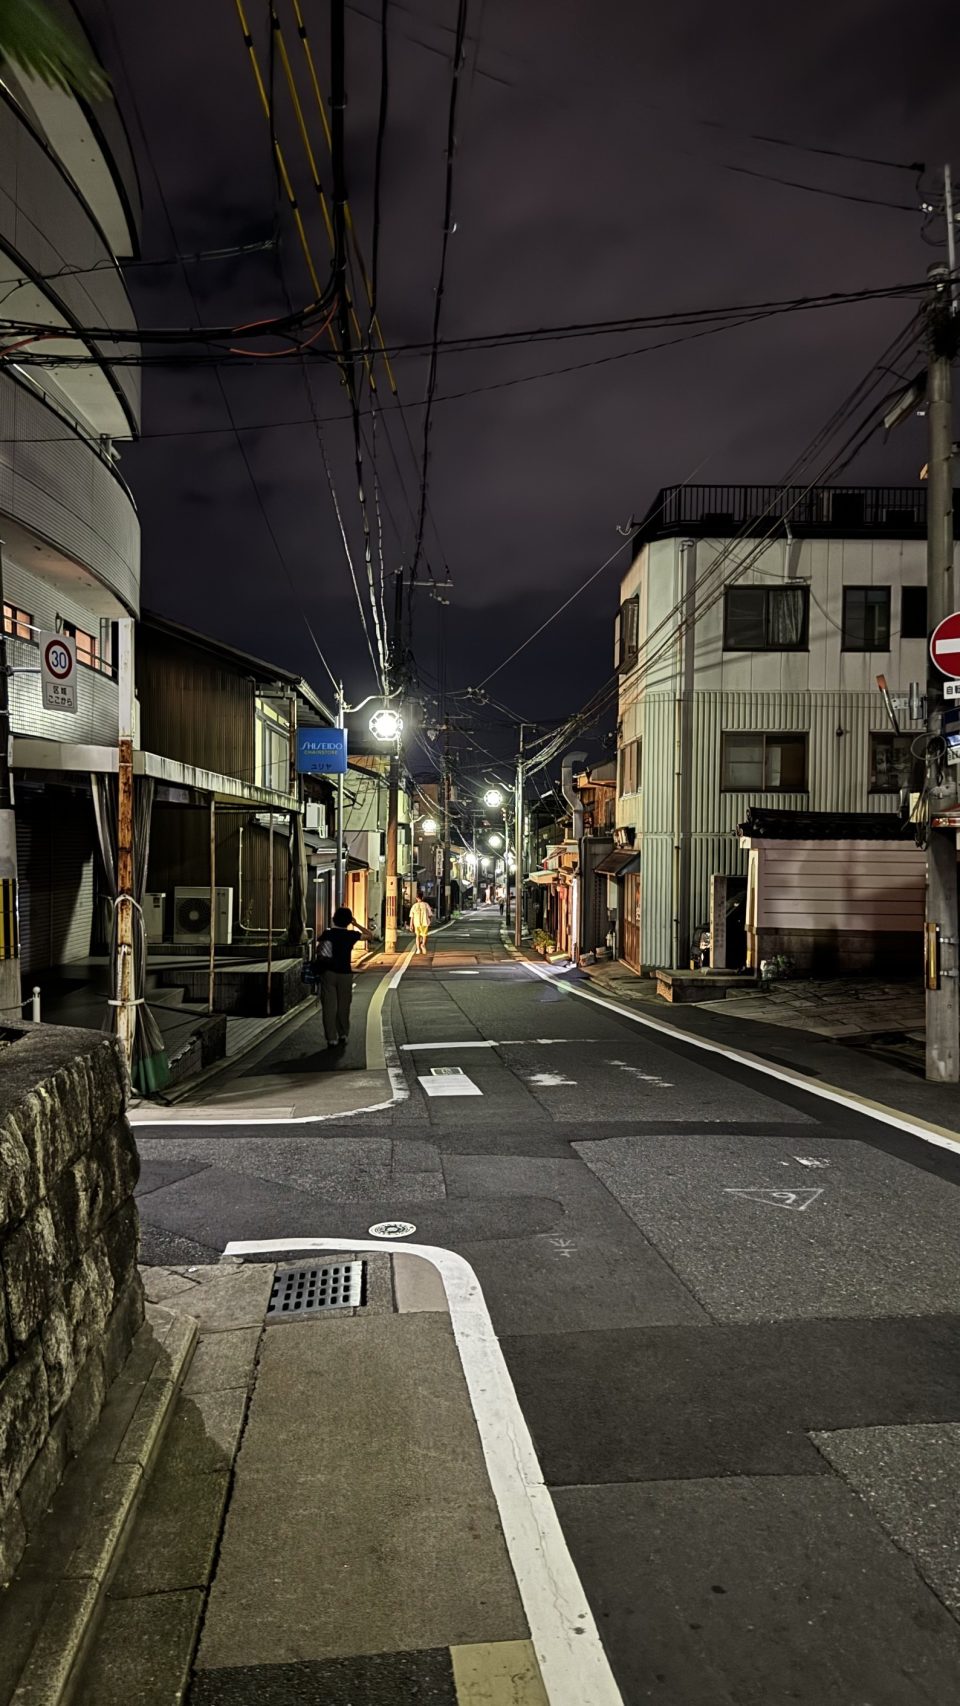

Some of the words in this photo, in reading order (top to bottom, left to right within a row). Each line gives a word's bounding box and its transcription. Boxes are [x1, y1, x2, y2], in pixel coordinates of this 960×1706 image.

[51, 651, 67, 669] 30
[48, 694, 73, 706] ここから
[301, 741, 343, 750] SHISEIDO
